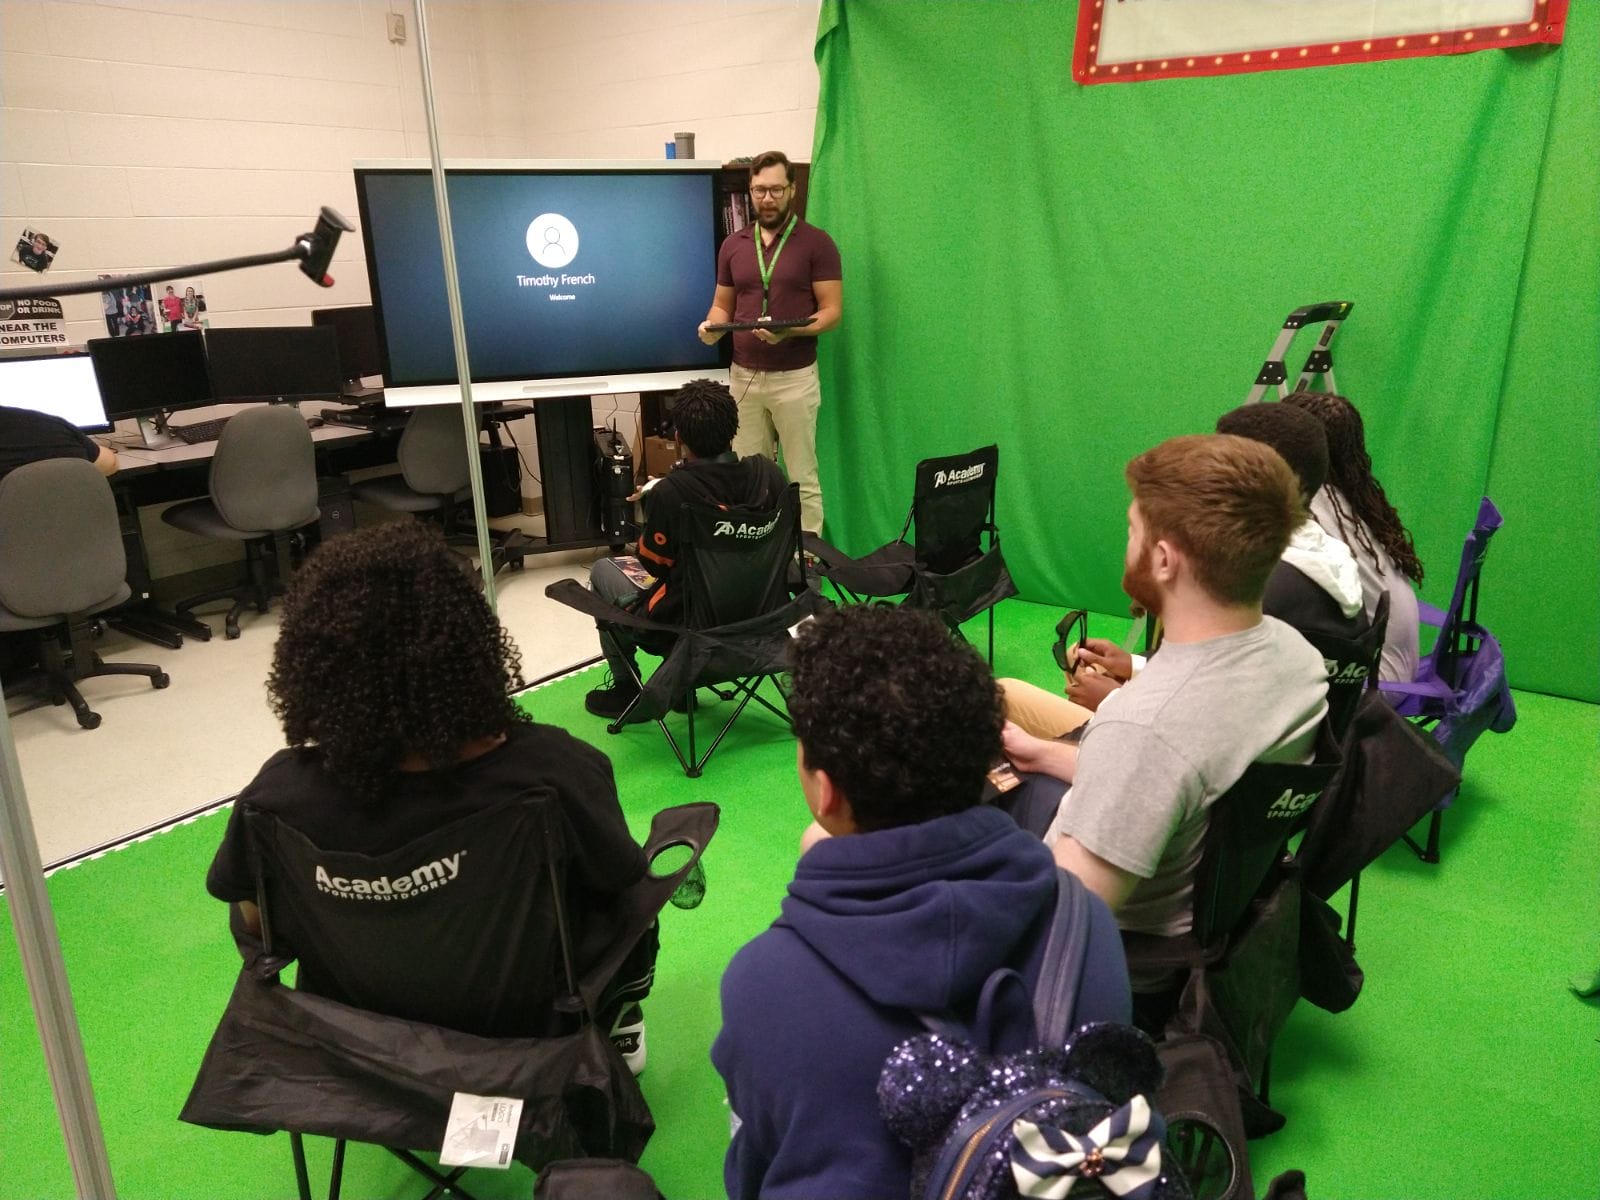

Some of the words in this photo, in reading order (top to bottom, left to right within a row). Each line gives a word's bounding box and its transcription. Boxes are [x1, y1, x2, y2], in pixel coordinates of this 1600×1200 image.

[516, 274, 559, 288] Timothy
[561, 273, 596, 285] French
[32, 306, 61, 314] DRINK
[33, 322, 57, 331] THE
[0, 334, 66, 345] OMPUTERS
[316, 853, 460, 894] Academy
